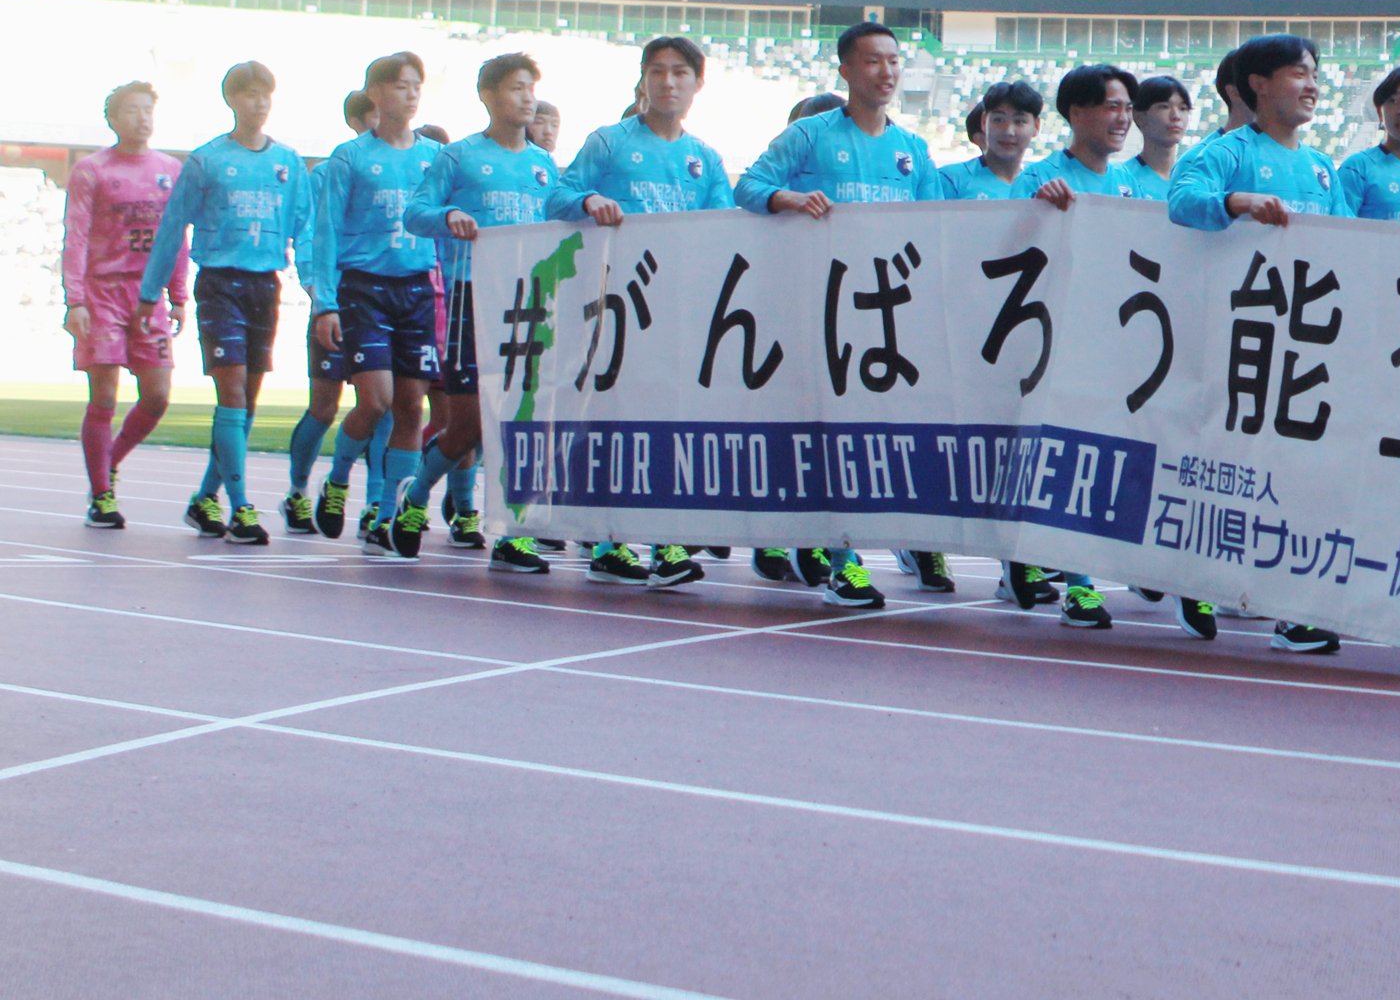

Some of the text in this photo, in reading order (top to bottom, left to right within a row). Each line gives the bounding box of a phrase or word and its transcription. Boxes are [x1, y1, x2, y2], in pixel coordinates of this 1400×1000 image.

[130, 229, 154, 252] 22
[249, 221, 262, 247] 4
[514, 431, 575, 495] PRAY
[587, 431, 652, 495] FOR
[1161, 455, 1279, 505] 一般社団法人
